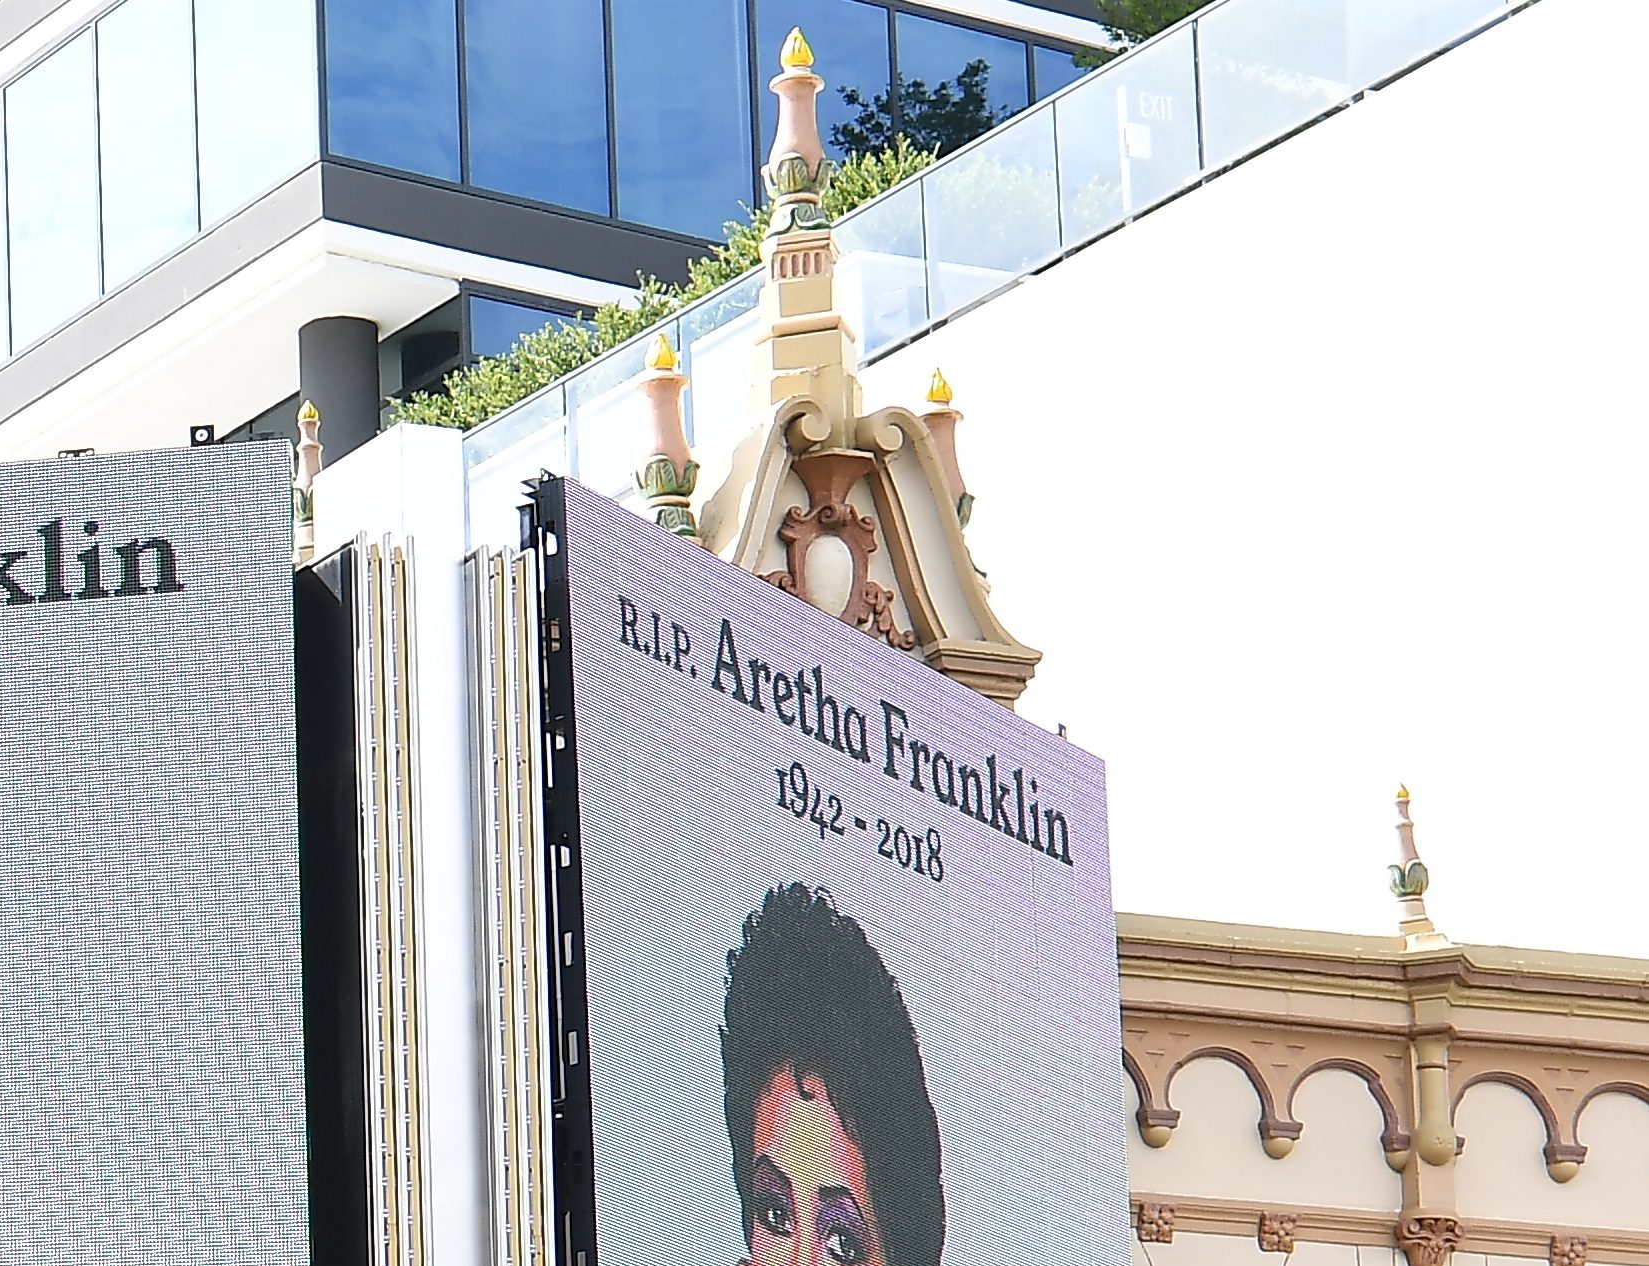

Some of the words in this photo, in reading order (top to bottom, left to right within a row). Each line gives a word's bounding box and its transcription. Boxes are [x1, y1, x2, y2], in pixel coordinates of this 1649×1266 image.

[1139, 91, 1173, 121] EXIT
[617, 594, 697, 679] R.I.P.
[711, 617, 871, 764] Aretha
[879, 699, 1074, 867] Franklin
[775, 760, 846, 841] 1942
[877, 817, 945, 884] 2018
